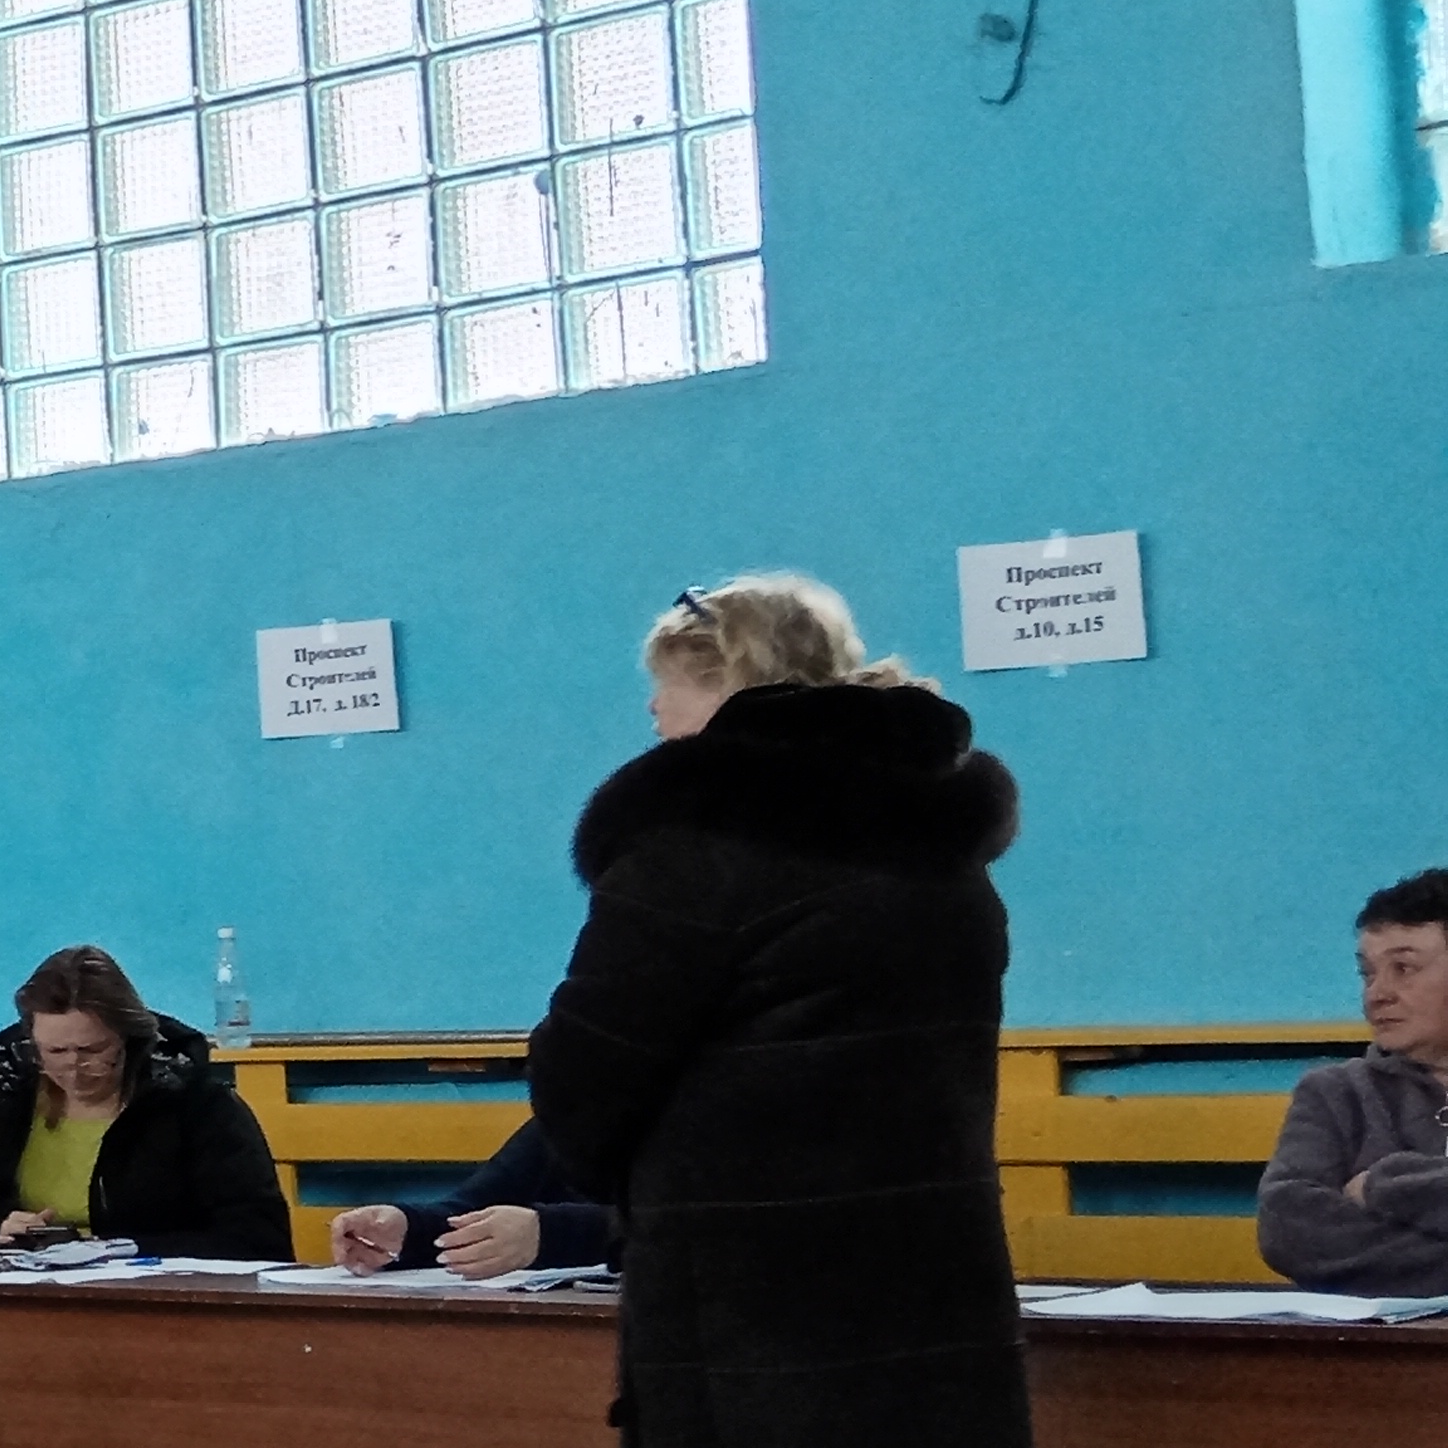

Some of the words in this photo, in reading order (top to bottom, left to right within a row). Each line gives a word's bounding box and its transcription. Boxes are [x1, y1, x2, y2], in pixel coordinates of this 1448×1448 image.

[1006, 561, 1103, 586] Проспект
[995, 586, 1117, 614] Строителей
[294, 644, 368, 666] Проспект
[286, 666, 377, 691] Строителей
